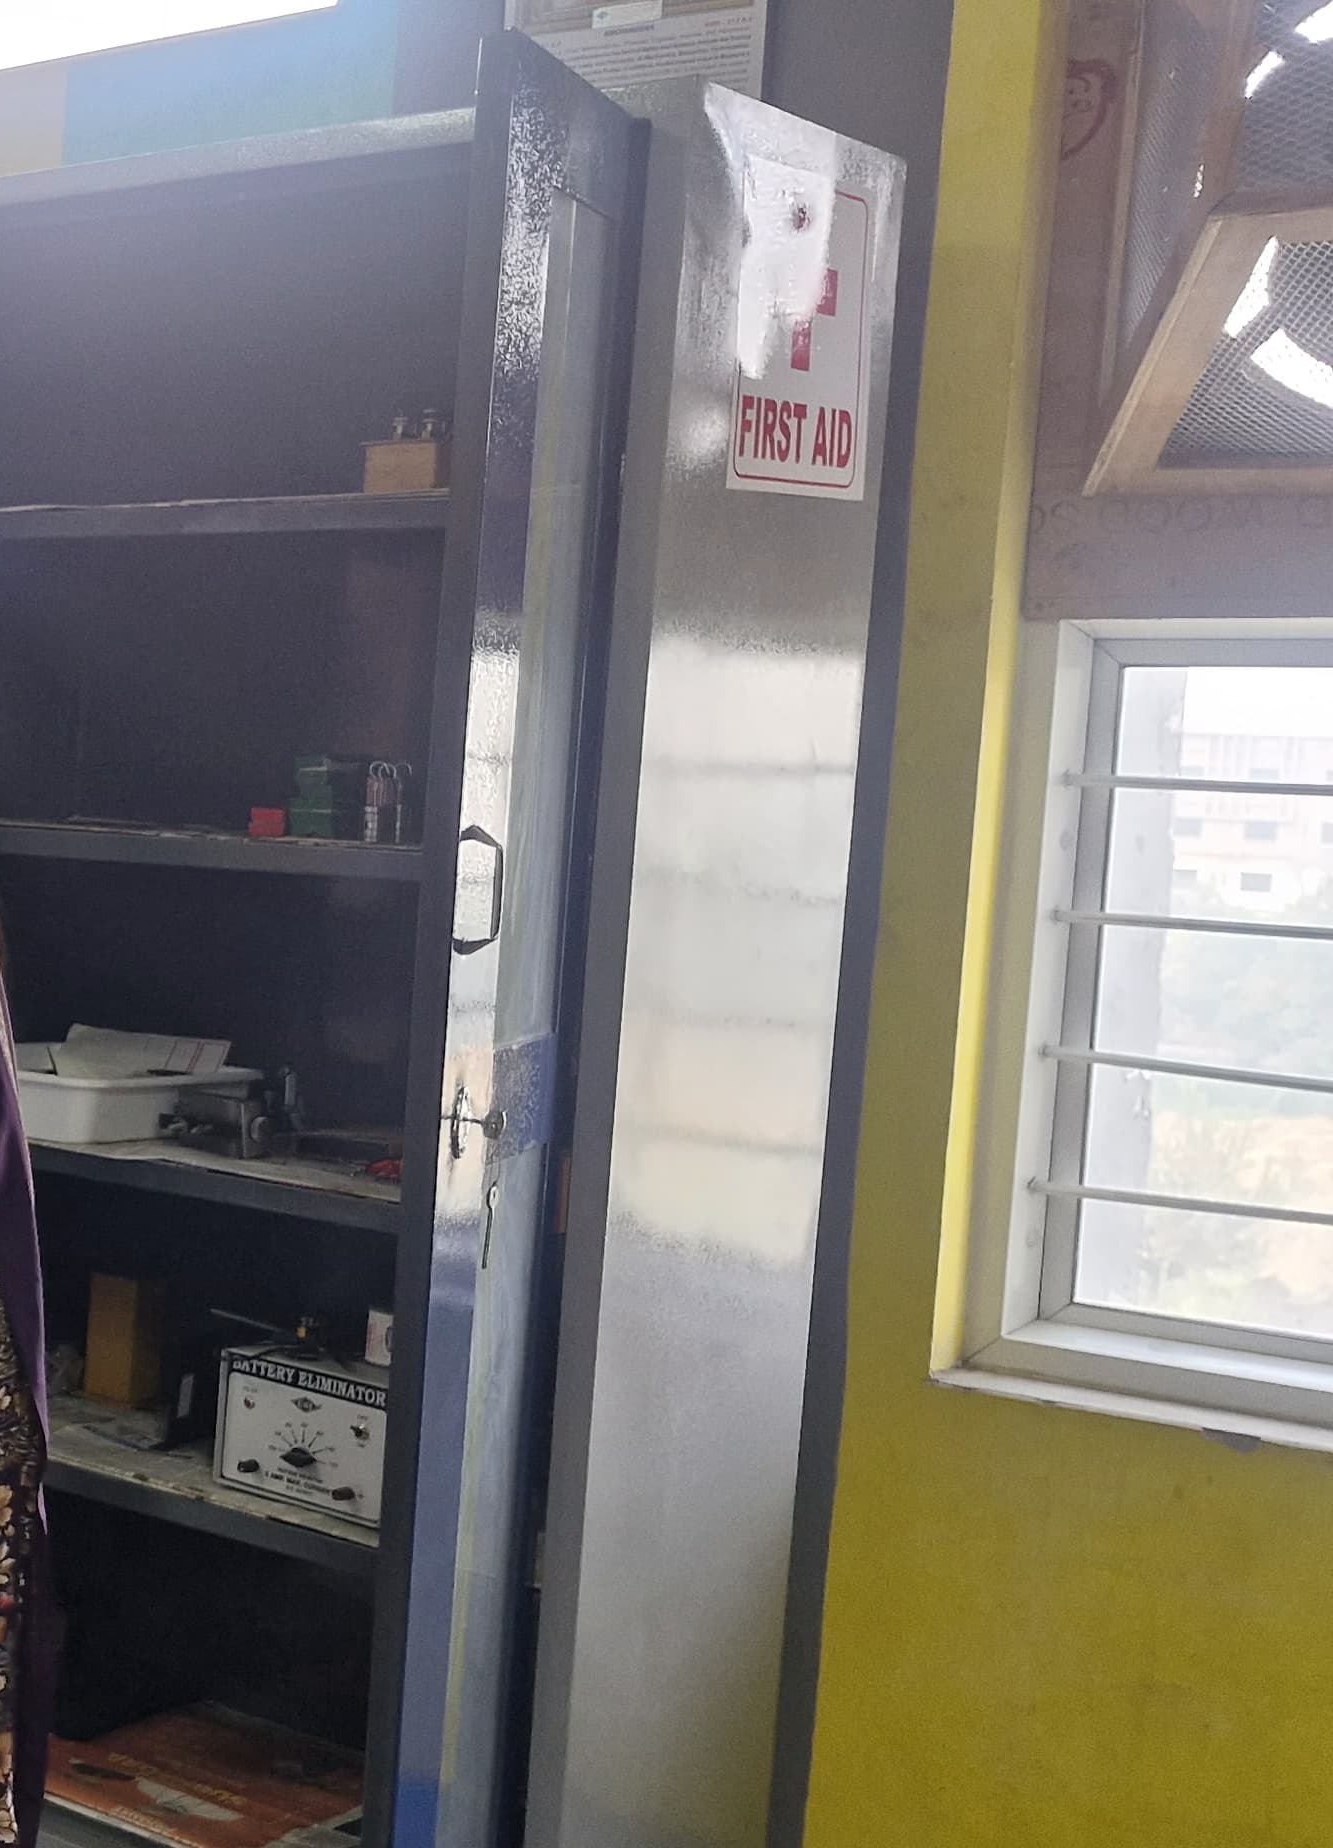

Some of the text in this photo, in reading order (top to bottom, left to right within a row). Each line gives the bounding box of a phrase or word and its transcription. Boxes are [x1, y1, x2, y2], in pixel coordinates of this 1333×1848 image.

[739, 395, 852, 468] FIRST AID
[233, 1358, 387, 1407] BATTERY ELIMINATOR
